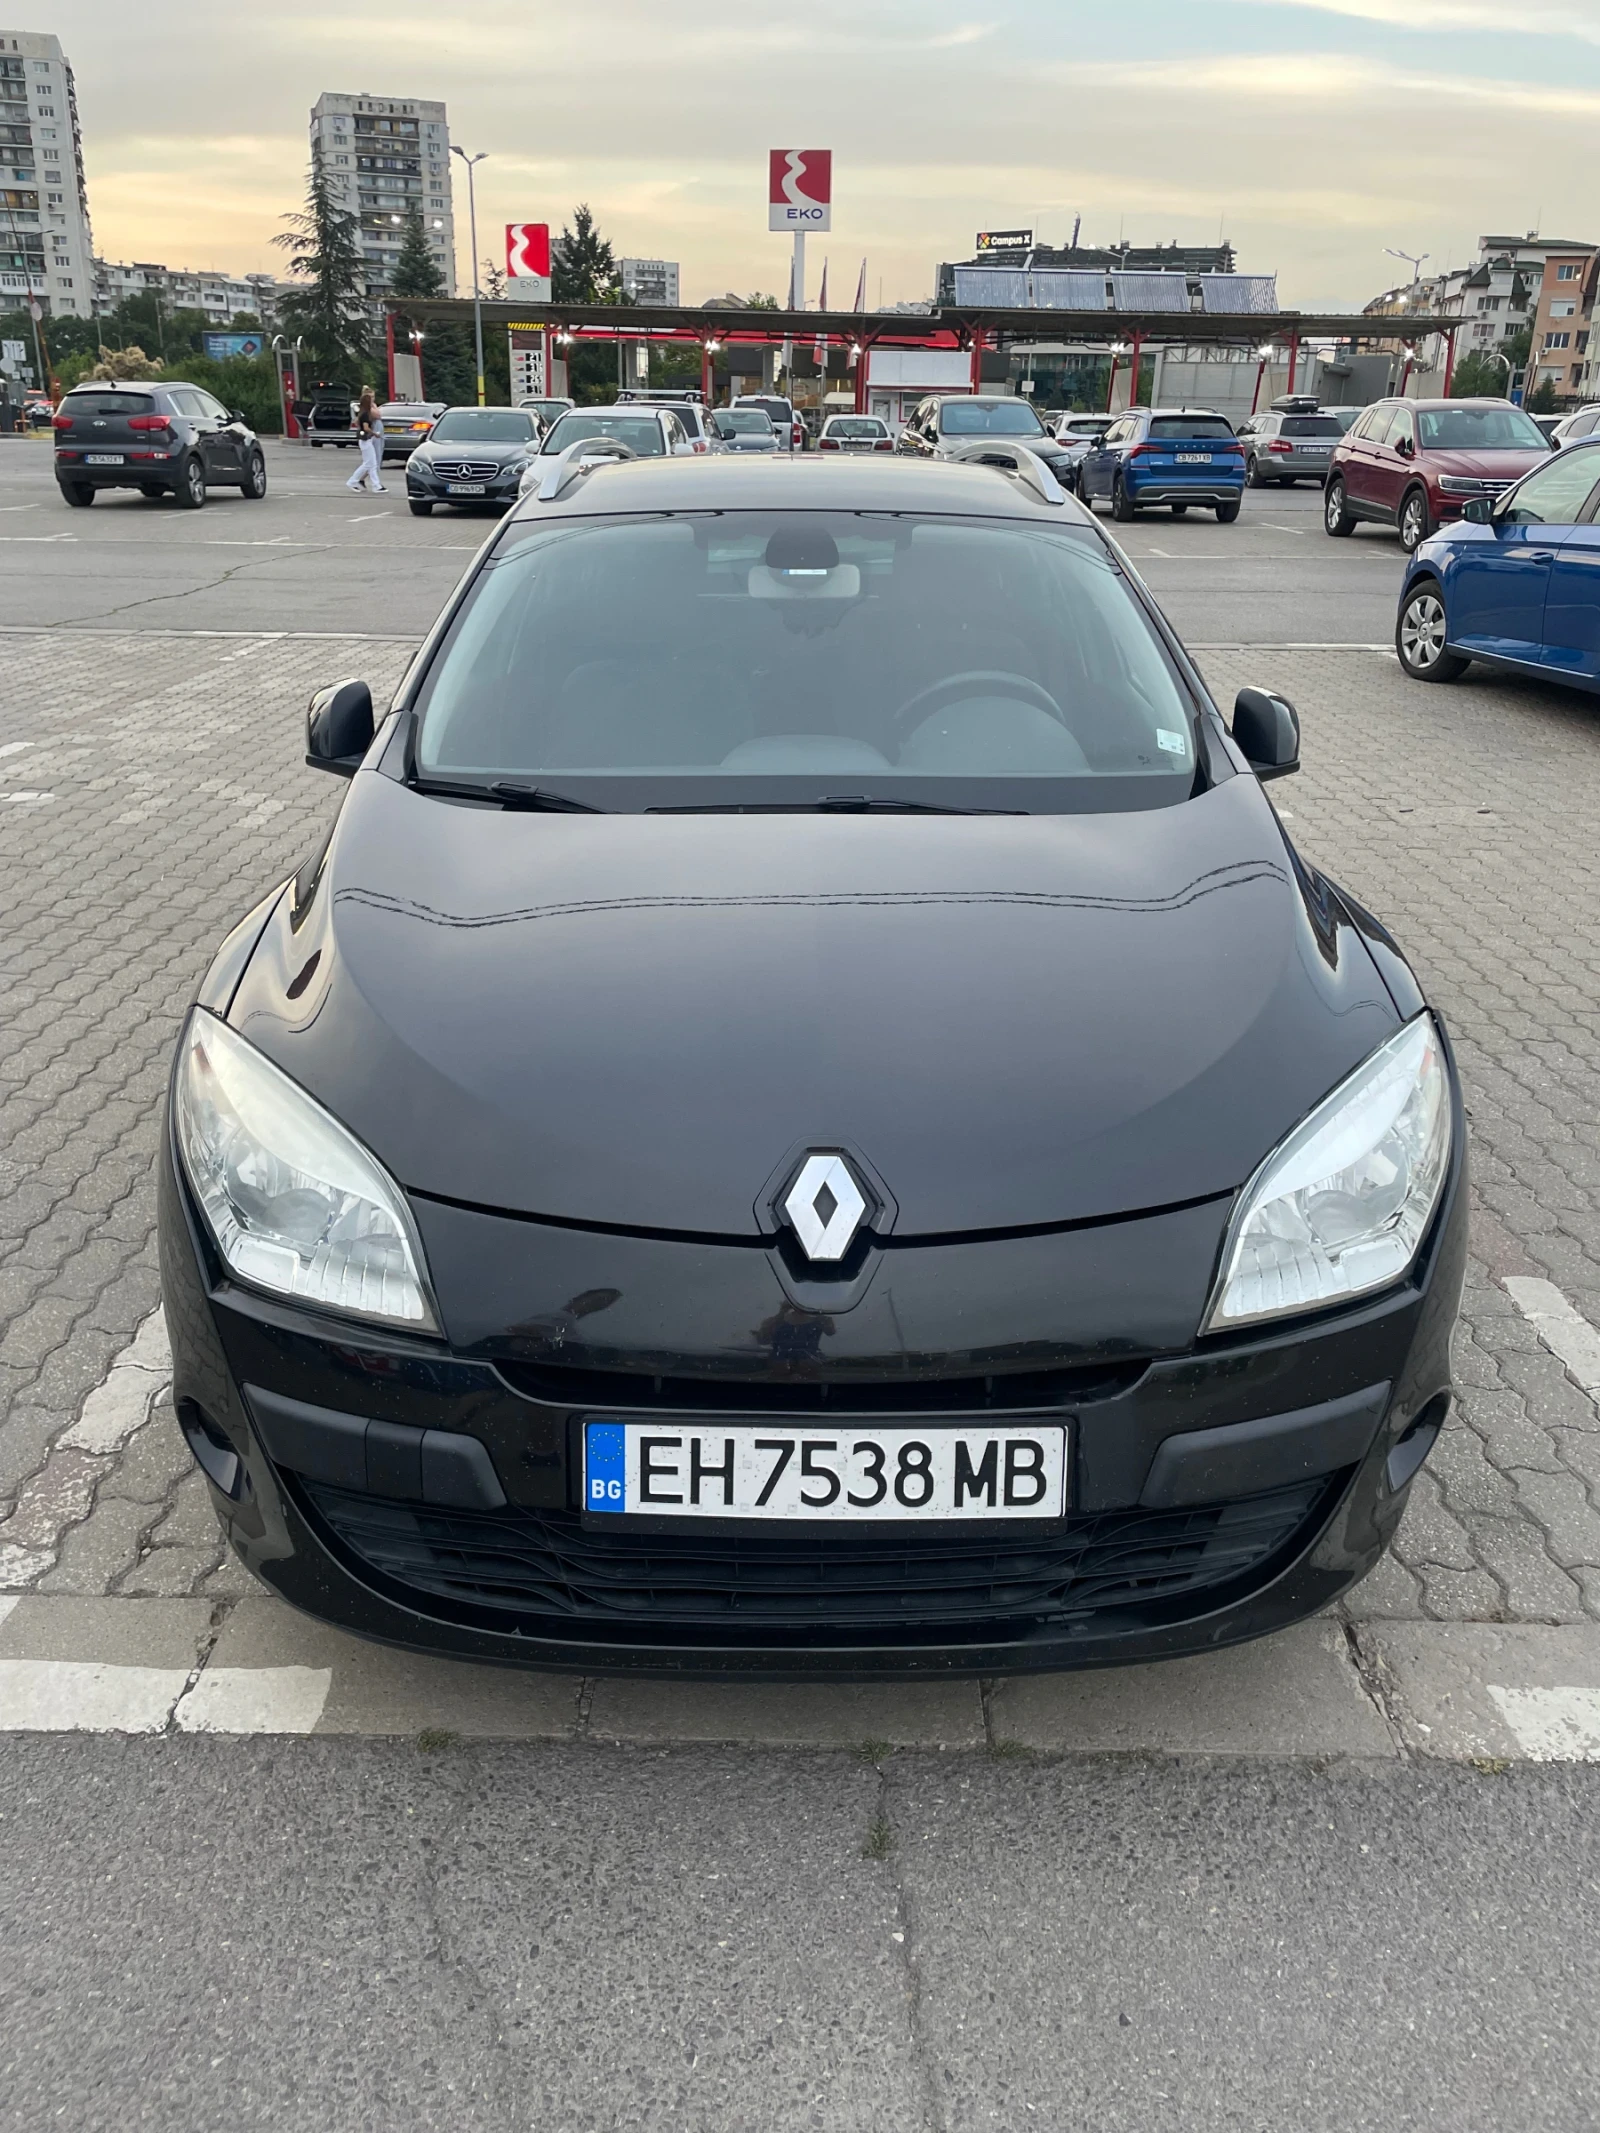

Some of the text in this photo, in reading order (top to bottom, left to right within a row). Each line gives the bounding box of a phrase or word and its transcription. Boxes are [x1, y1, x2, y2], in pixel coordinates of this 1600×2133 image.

[787, 208, 823, 219] EKO
[990, 234, 1030, 246] Campus X
[520, 280, 540, 288] EKO
[953, 1439, 1047, 1508] MB
[591, 1480, 622, 1500] BG
